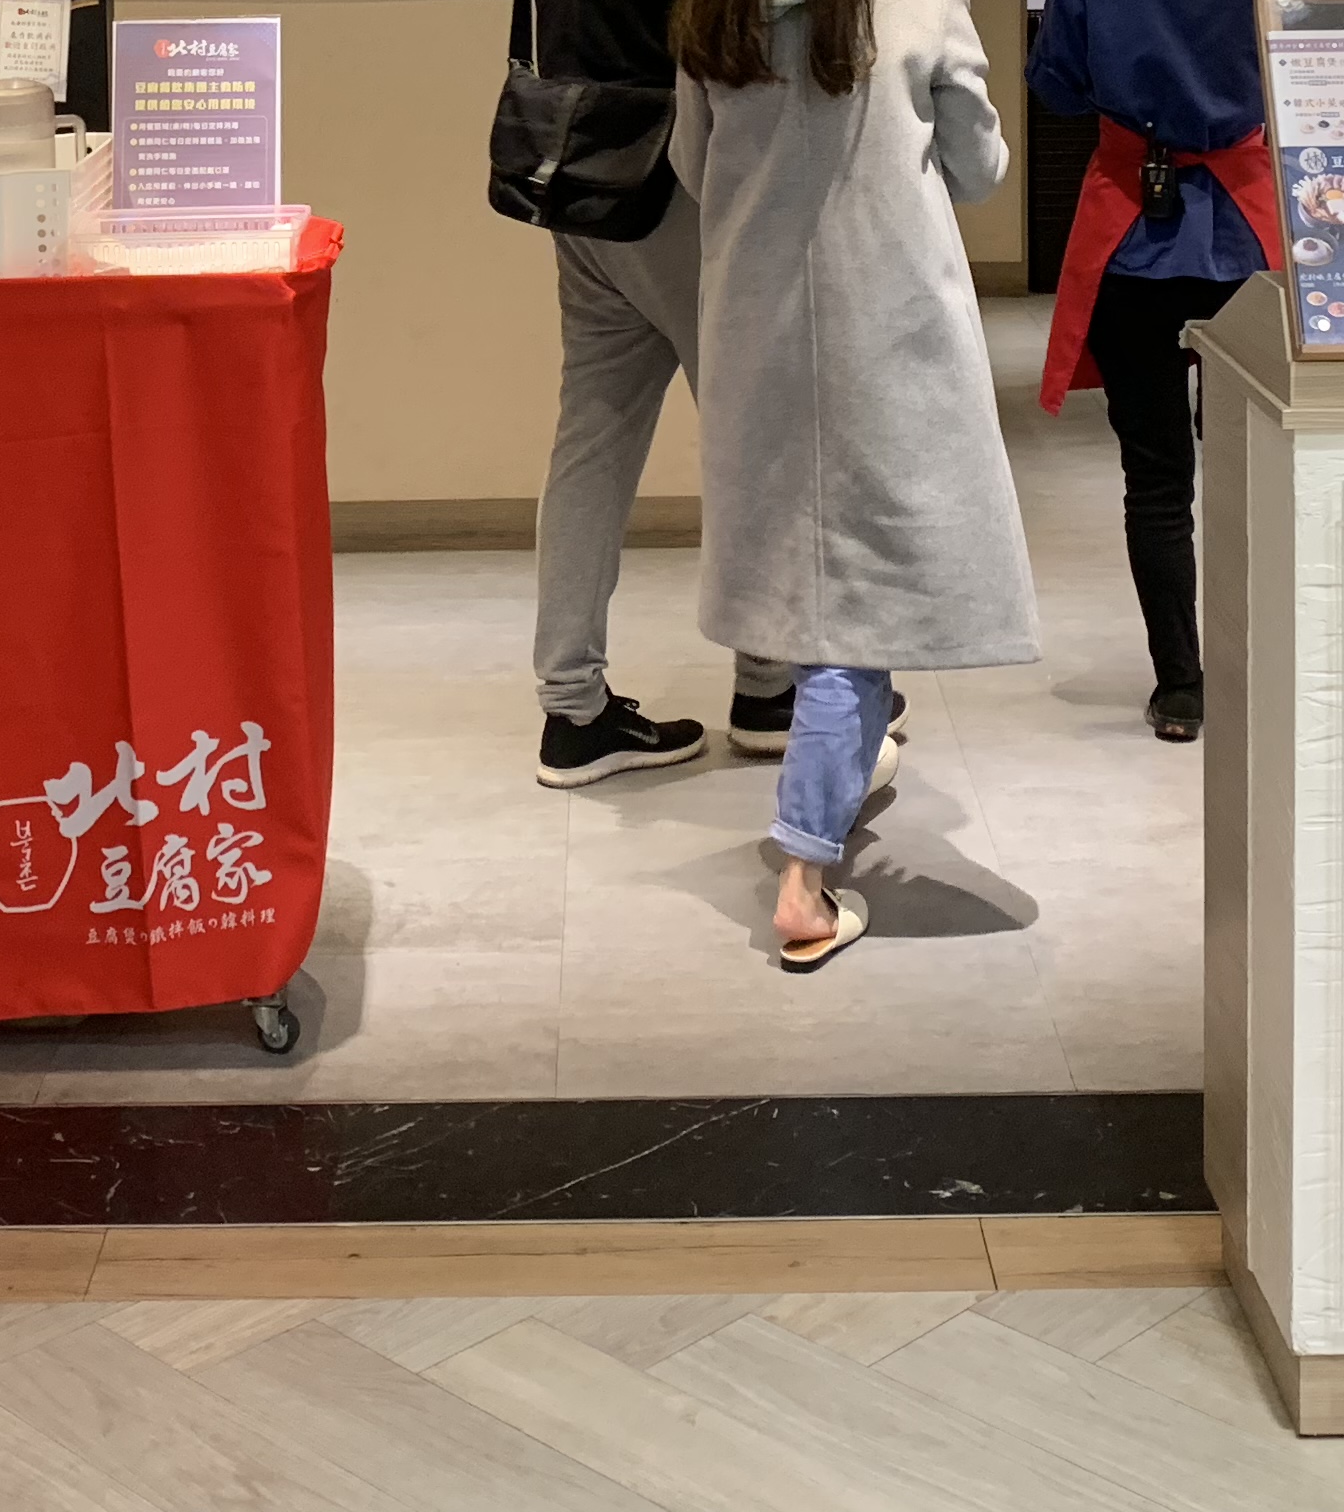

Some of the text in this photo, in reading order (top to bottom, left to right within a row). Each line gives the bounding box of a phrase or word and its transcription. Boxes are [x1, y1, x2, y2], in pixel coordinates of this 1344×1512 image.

[167, 39, 239, 57] 北村豆腐家
[43, 721, 272, 838] 北村
[10, 820, 39, 891] 북촌
[89, 822, 273, 914] 豆腐家
